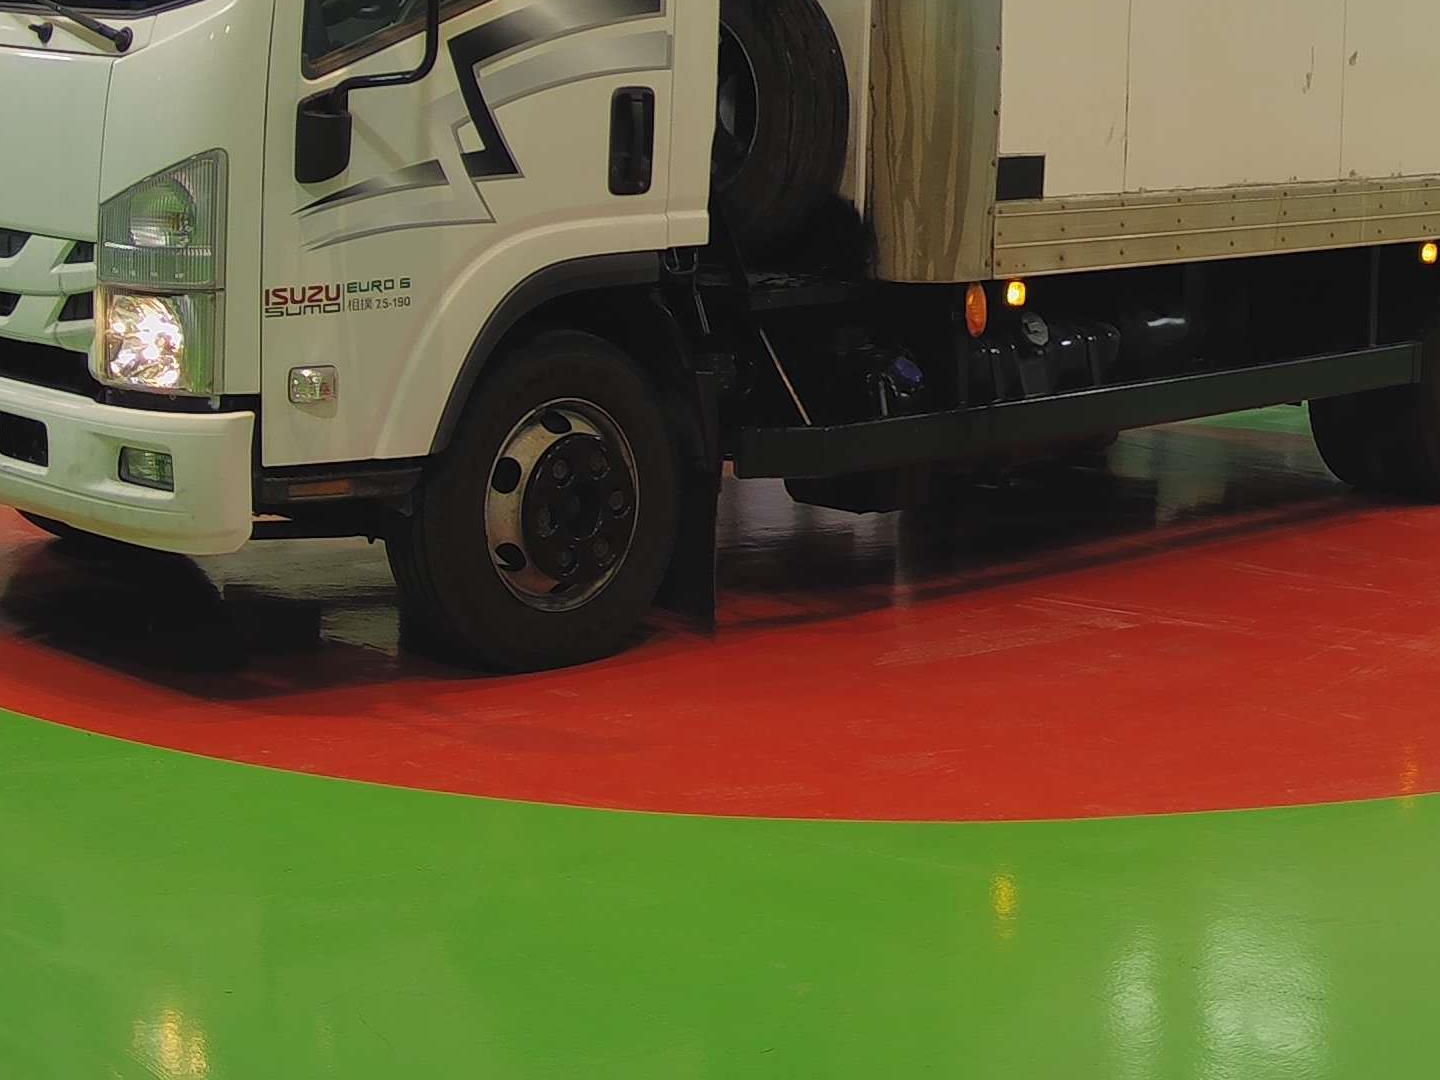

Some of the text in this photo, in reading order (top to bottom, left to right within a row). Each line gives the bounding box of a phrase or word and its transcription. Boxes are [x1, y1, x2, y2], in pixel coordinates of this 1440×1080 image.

[347, 277, 411, 293] EURO 6
[265, 284, 340, 306] ISUZU
[265, 303, 340, 318] SUMO
